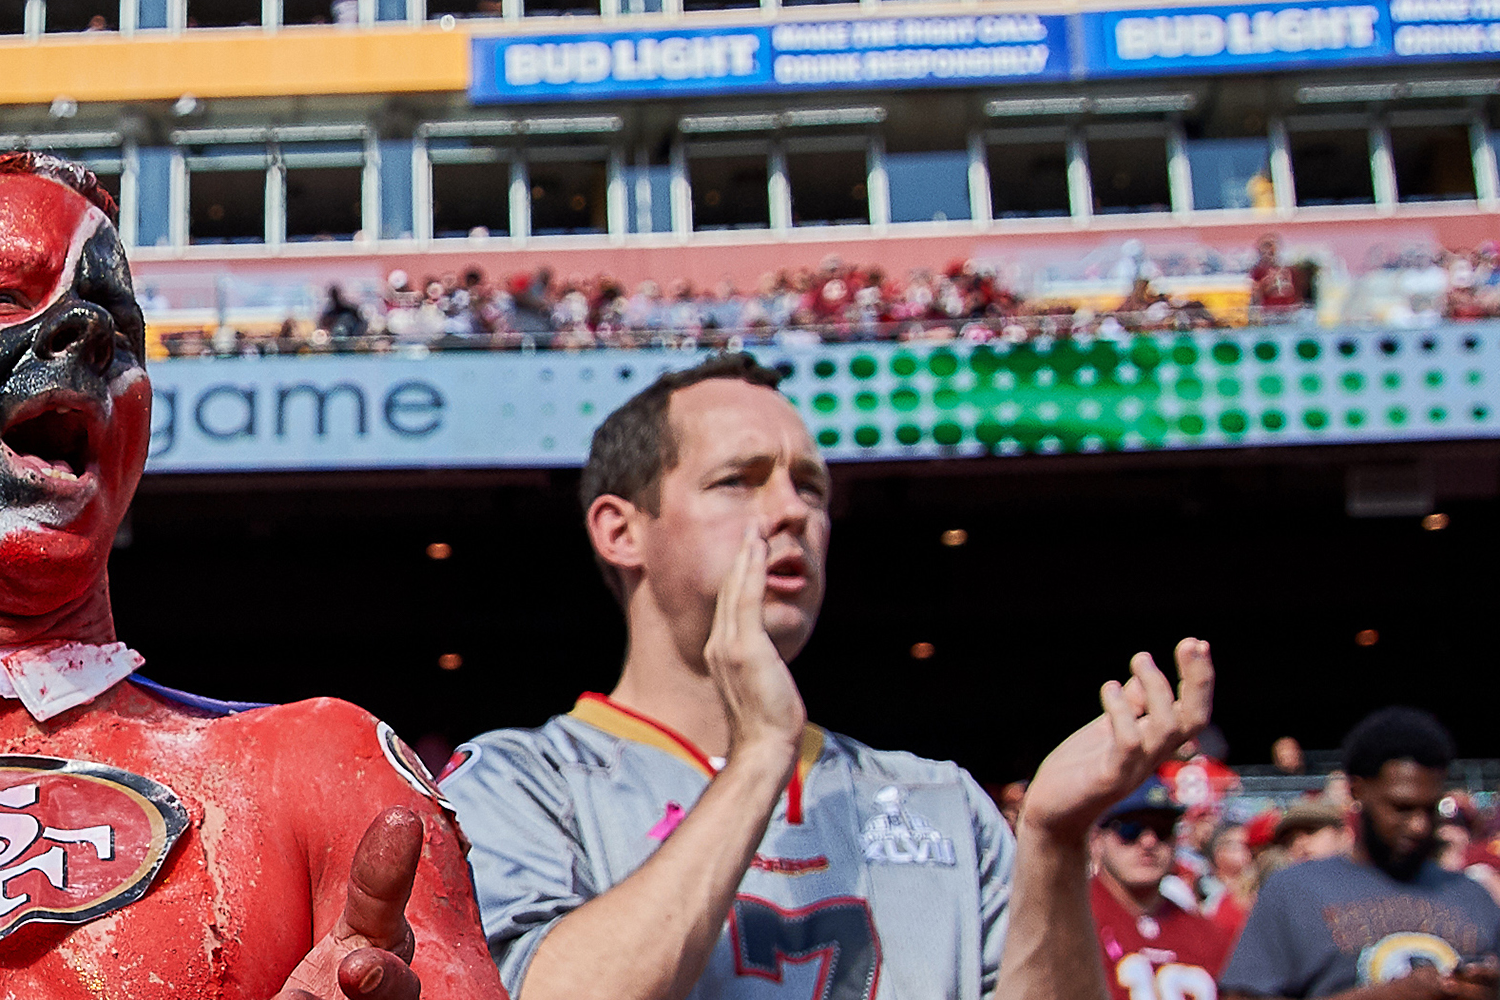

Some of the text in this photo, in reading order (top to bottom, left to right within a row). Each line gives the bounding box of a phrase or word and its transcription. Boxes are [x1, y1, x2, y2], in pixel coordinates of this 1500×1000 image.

[1115, 6, 1378, 60] BUD LIGHT
[504, 35, 760, 86] BUD LIGHT
[865, 837, 956, 866] XLVII
